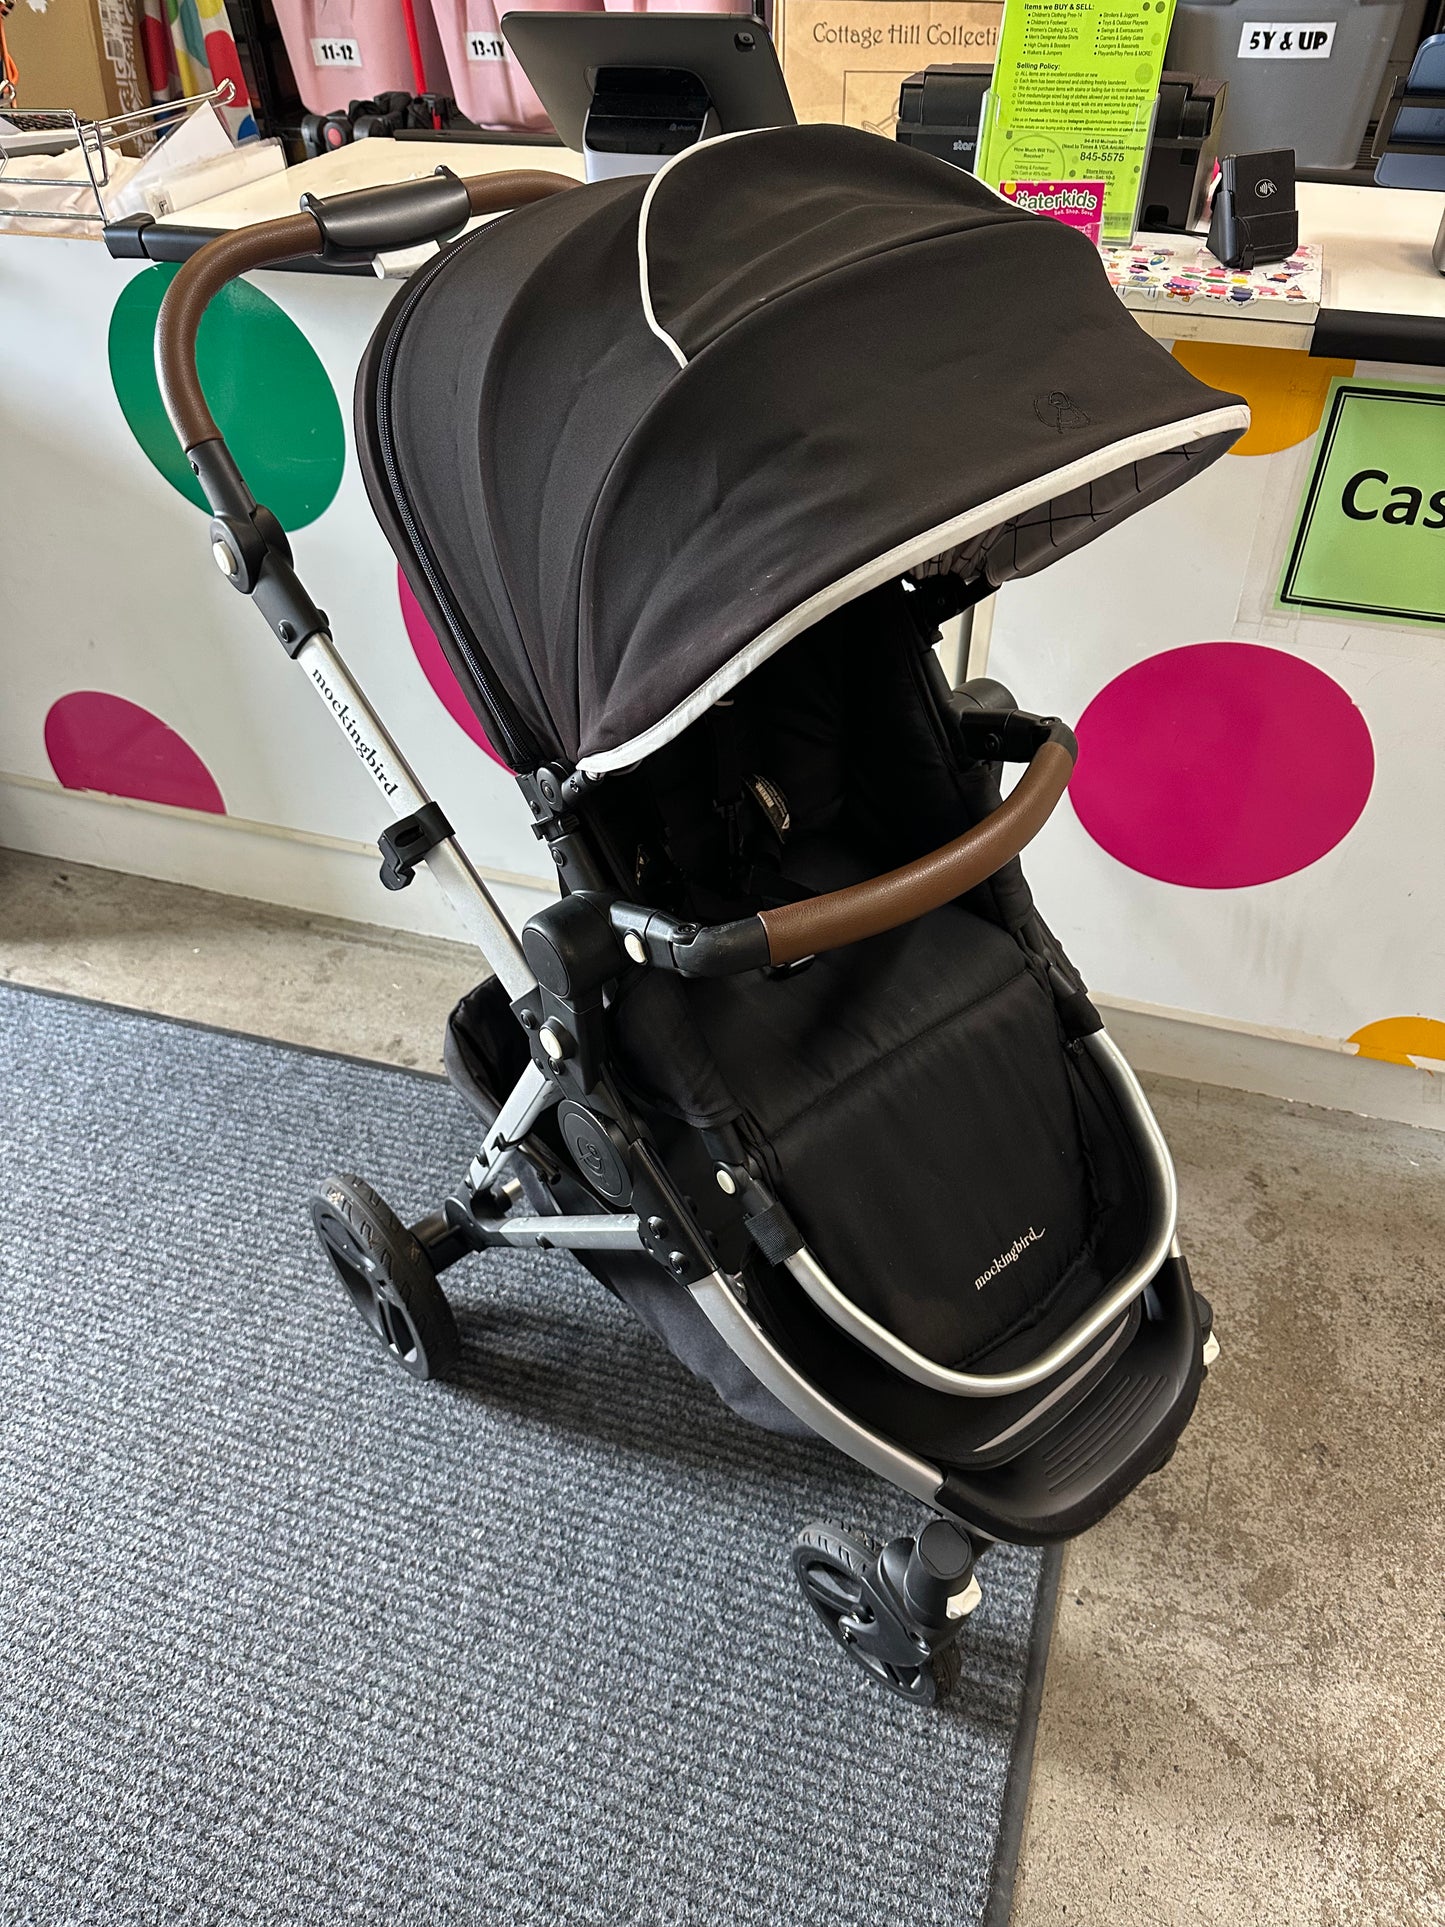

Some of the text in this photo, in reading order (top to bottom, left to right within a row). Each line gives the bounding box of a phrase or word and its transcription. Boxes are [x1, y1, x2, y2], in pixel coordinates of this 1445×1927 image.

[813, 22, 999, 49] Cottage Hill Collecti
[1249, 31, 1328, 50] 5Y & UP
[321, 44, 354, 60] 11-12
[1016, 62, 1060, 70] Selling Policy:
[1080, 152, 1124, 162] 845-5575
[1017, 190, 1097, 210] caterkids
[1341, 469, 1445, 529] Cas
[312, 669, 399, 796] mockingbird
[974, 1226, 1046, 1290] mockingbird
